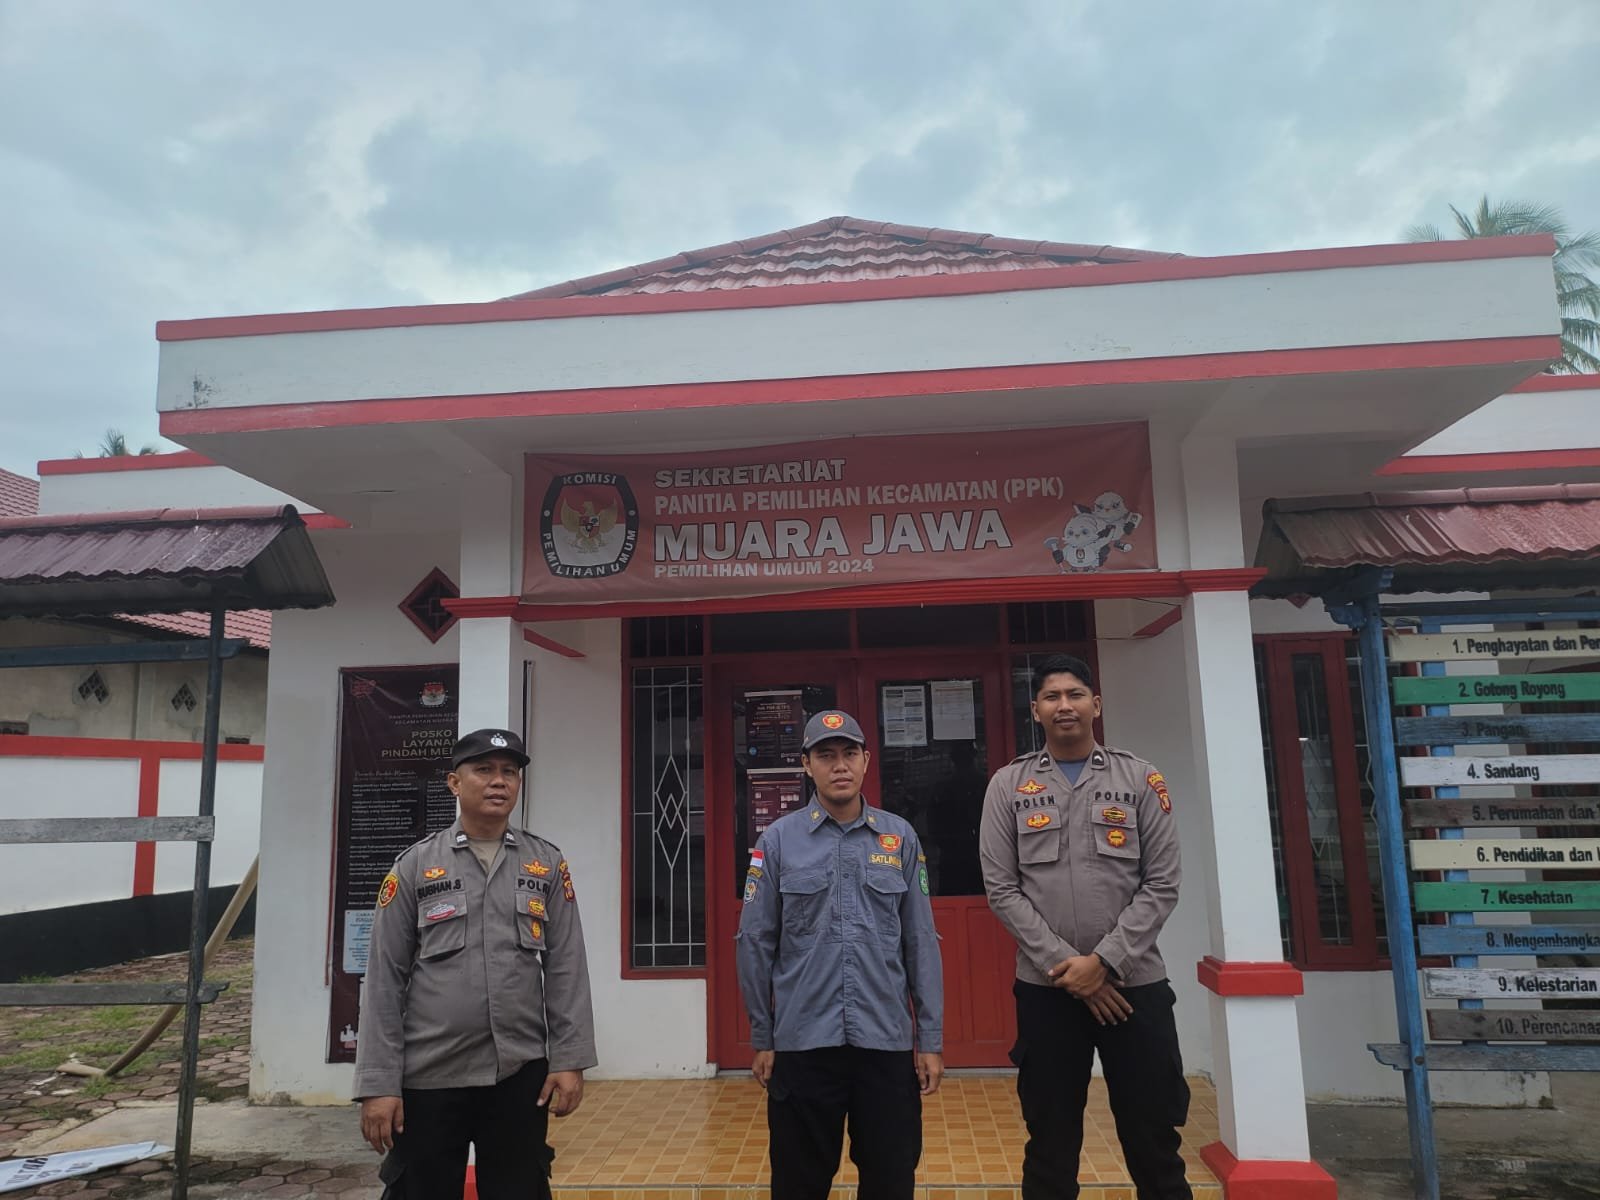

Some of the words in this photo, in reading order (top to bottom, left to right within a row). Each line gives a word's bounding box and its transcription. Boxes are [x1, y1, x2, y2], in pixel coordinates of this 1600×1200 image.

[563, 473, 617, 485] KOMISI
[655, 458, 846, 488] SEKRETARIAT
[655, 493, 737, 515] PANITIA
[743, 487, 861, 511] PEMILIHAN
[867, 480, 998, 505] KECAMATAN
[1003, 476, 1064, 504] (PPK)
[654, 516, 850, 562] MUARA
[862, 508, 1013, 556] JAWA
[543, 532, 605, 576] PEMILIHAN
[610, 530, 636, 572] UMUM
[655, 563, 758, 578] PEMILIHAN
[763, 560, 822, 577] UMUM
[827, 558, 874, 574] 2024
[1453, 639, 1464, 653] 1.
[1467, 638, 1549, 656] Penghayatan
[1553, 636, 1577, 650] dan
[1458, 682, 1470, 697] 2.
[1474, 681, 1518, 699] Gotong
[1521, 681, 1566, 699] Royong
[411, 729, 452, 738] POSKO
[381, 748, 427, 757] PINDAH
[1467, 763, 1480, 779] 4.
[1484, 763, 1540, 781] Sandang
[1094, 791, 1136, 804] POLRI
[1472, 805, 1485, 821] 5.
[1489, 805, 1564, 820] Perumahan
[1569, 804, 1595, 819] dan
[1476, 847, 1490, 862] 6.
[1493, 847, 1565, 862] Pendidikan
[1569, 846, 1593, 862] dan
[1480, 889, 1495, 904] 7.
[1499, 890, 1573, 905] Kesehatan
[1486, 932, 1500, 947] 8.
[1498, 976, 1512, 992] 9.
[1516, 976, 1597, 992] Kelestarian
[1496, 1018, 1518, 1034] 10.
